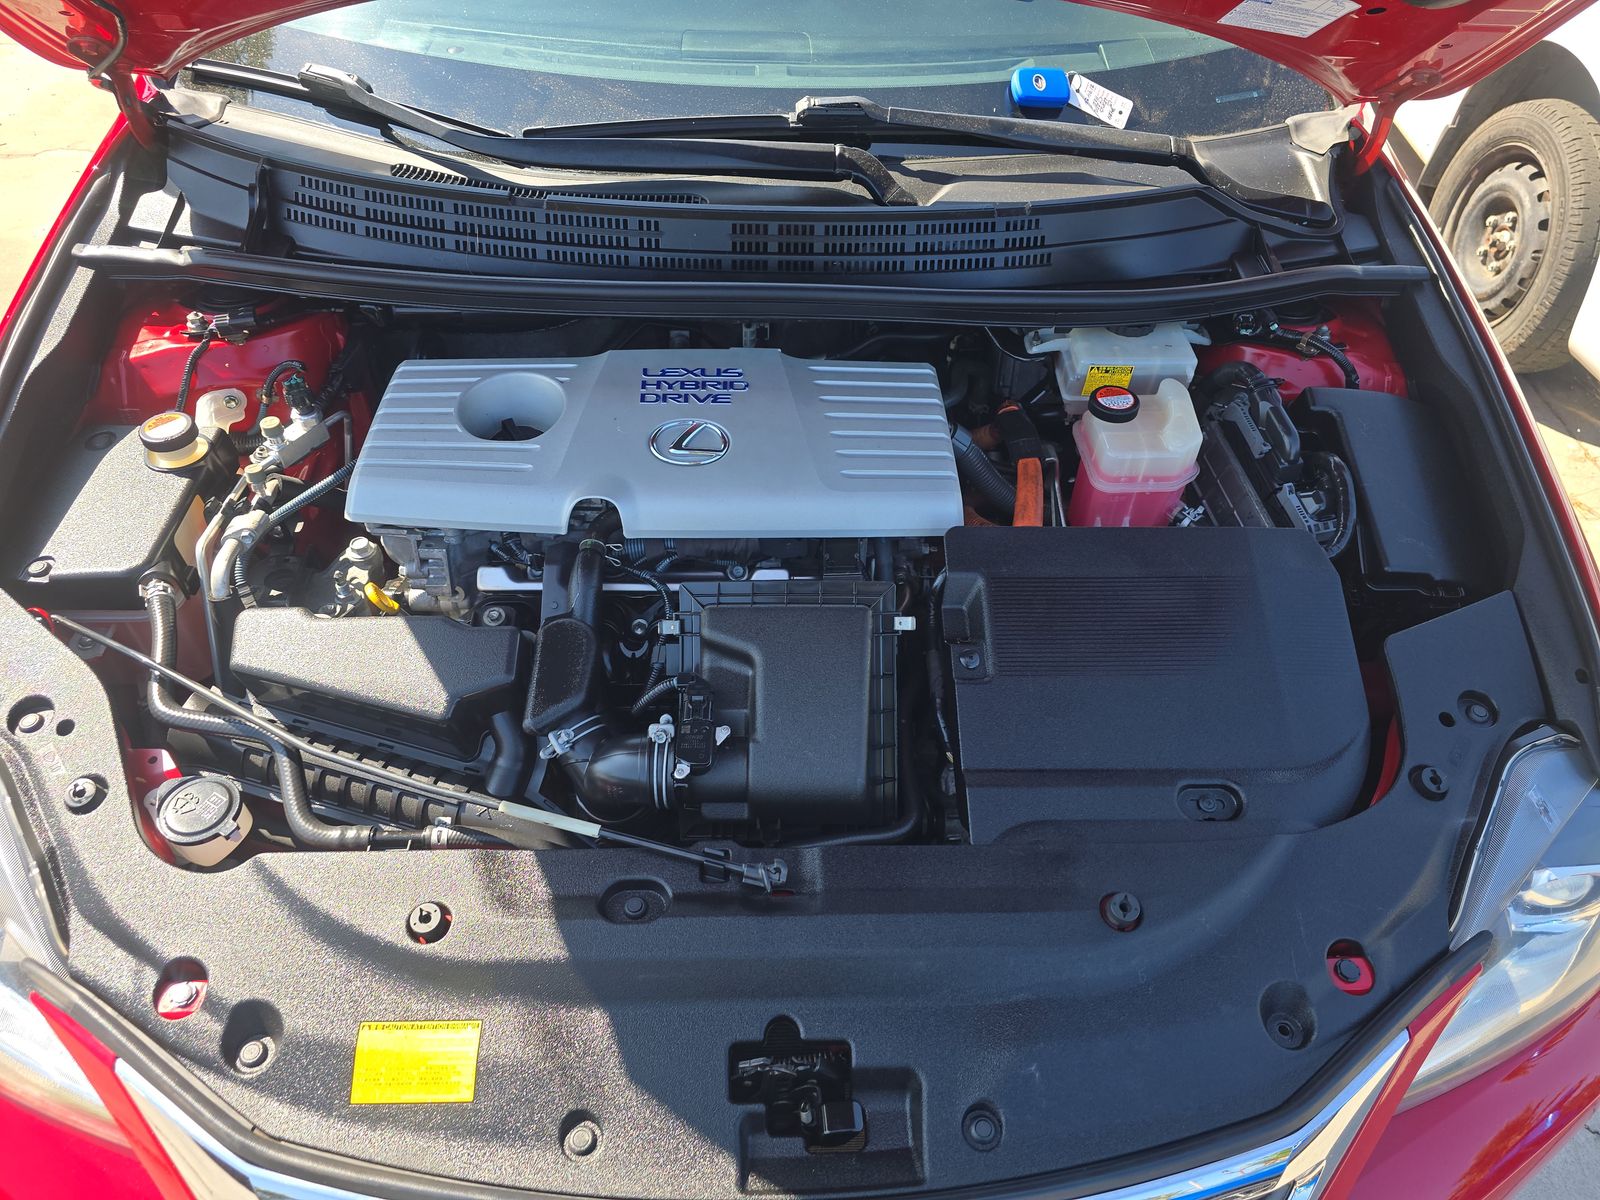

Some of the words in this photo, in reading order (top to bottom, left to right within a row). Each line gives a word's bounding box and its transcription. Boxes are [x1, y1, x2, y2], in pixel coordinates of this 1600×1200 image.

[642, 367, 744, 378] LEXUS
[640, 380, 749, 391] HYBRID
[640, 393, 732, 405] DRIVE
